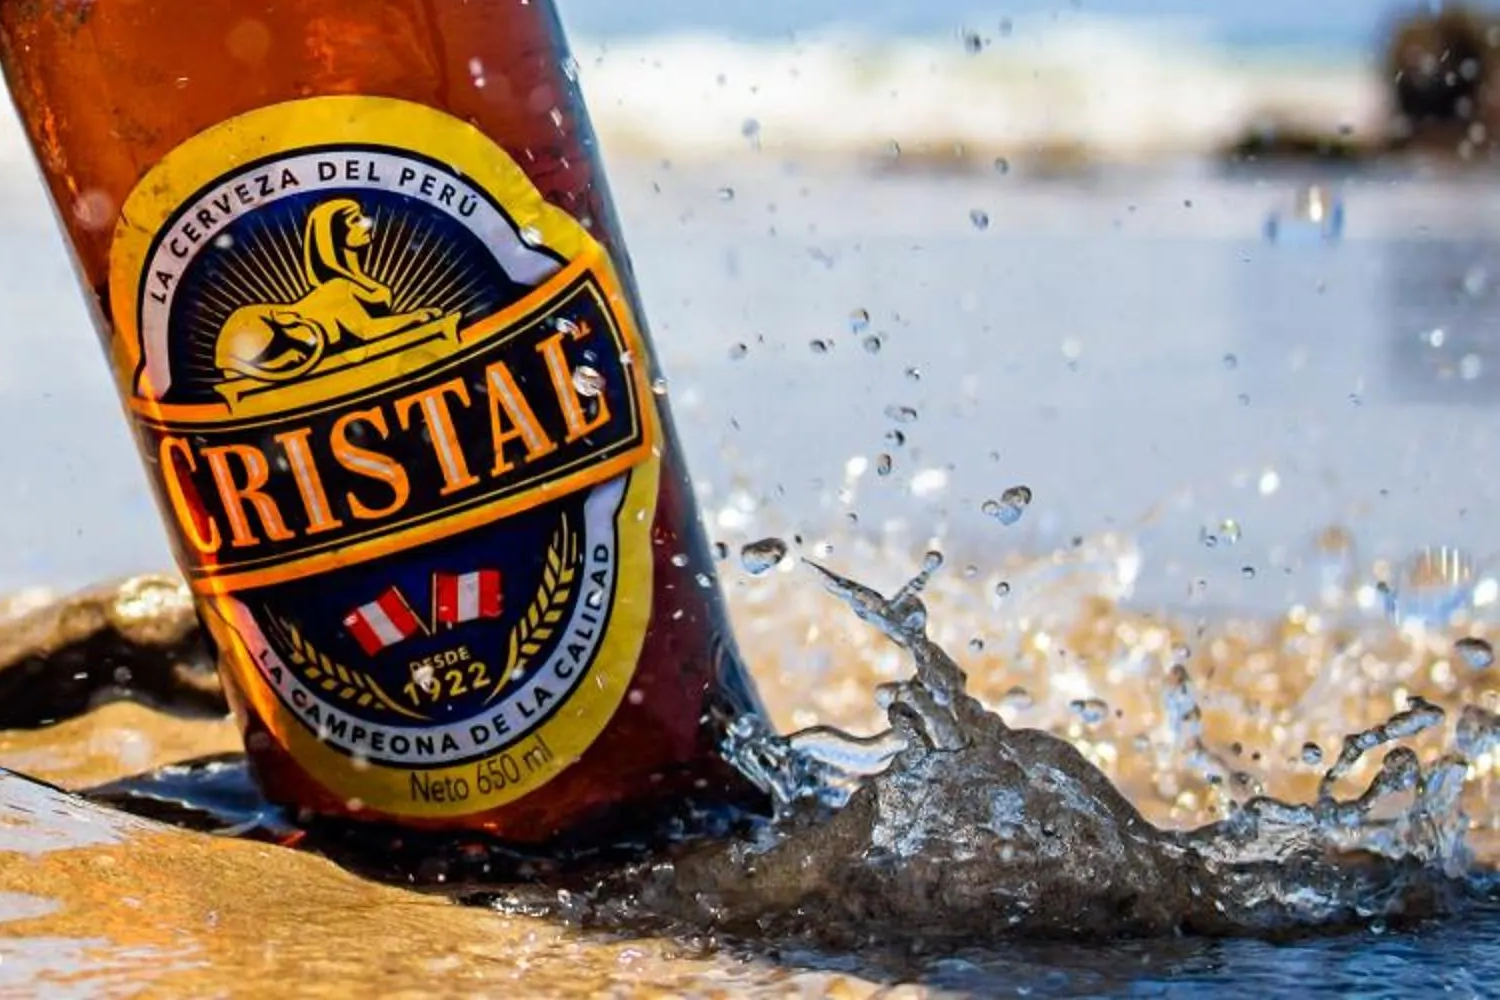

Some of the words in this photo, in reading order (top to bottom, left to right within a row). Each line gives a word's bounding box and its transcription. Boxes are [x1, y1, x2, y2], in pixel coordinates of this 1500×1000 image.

[148, 267, 172, 304] LA
[169, 167, 300, 259] CERVEZA
[317, 159, 381, 183] DEL
[399, 168, 480, 220] PERÚ
[158, 320, 612, 556] CRISTAL
[258, 649, 283, 686] LA
[291, 687, 459, 756] CAMPEONA
[473, 717, 510, 746] DE
[521, 685, 555, 720] LA
[554, 542, 610, 679] CALIDAD
[403, 661, 492, 707] 1922
[410, 769, 470, 803] Neto
[476, 756, 521, 796] 650
[523, 733, 554, 776] ml
